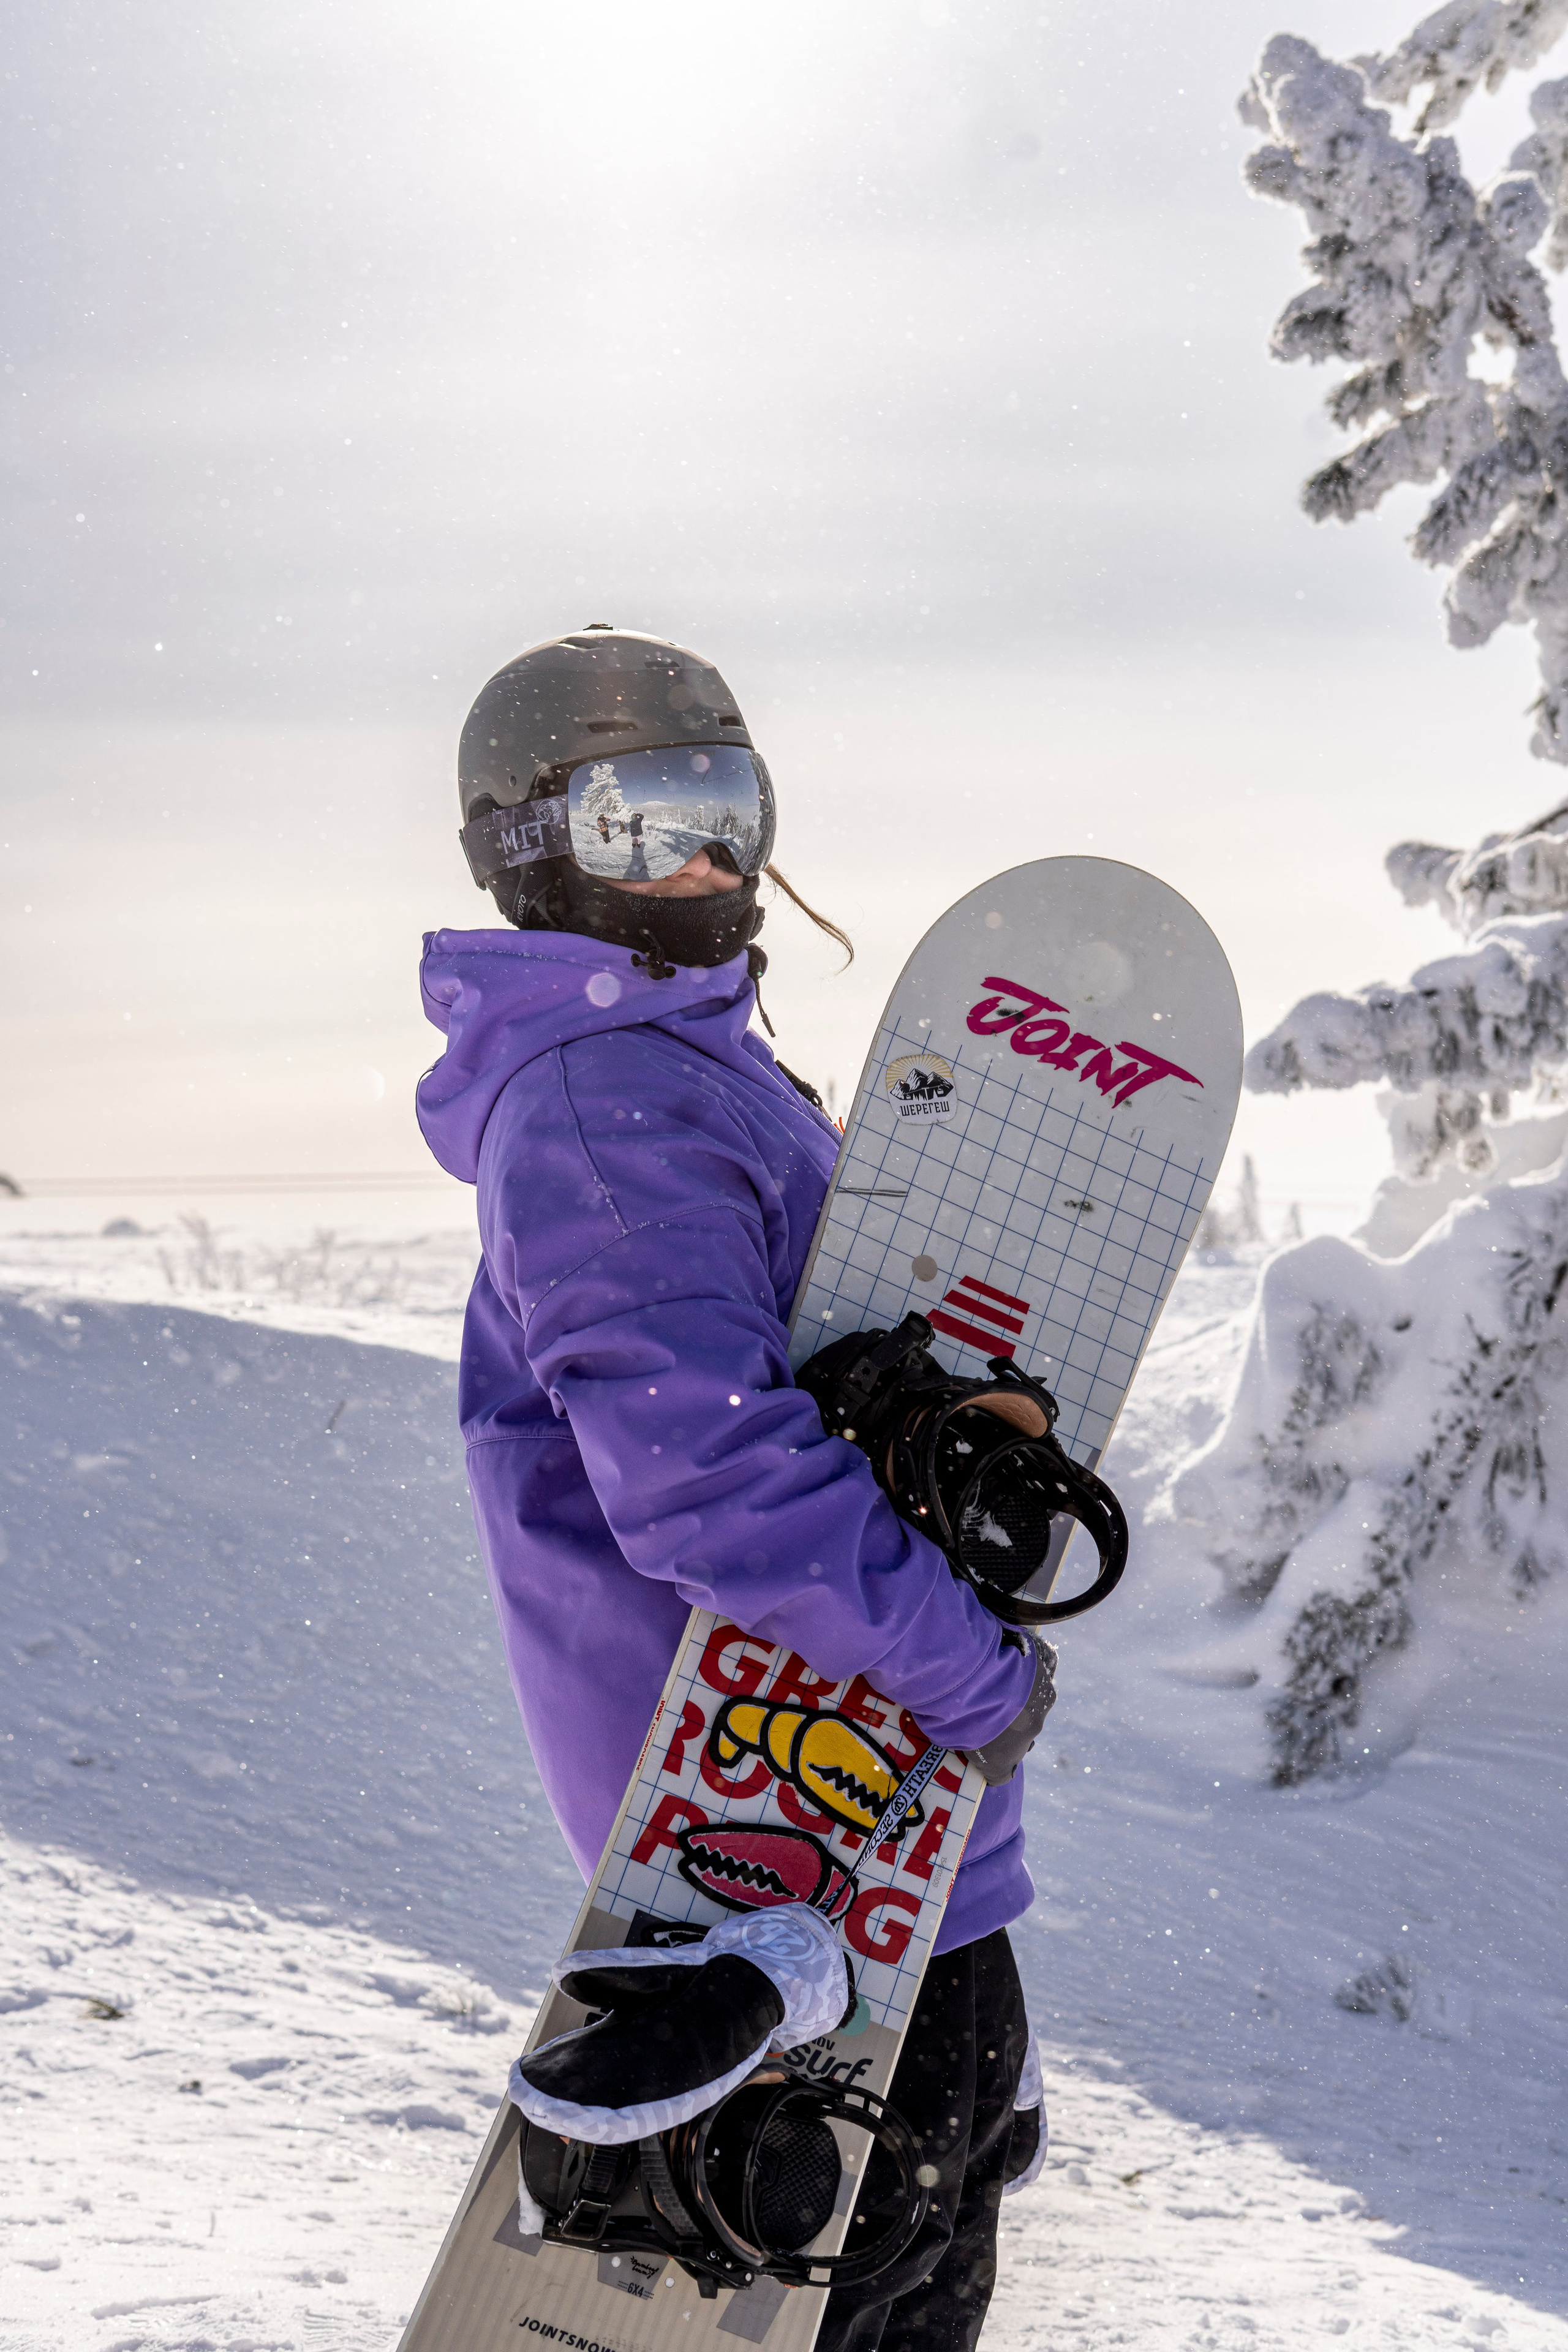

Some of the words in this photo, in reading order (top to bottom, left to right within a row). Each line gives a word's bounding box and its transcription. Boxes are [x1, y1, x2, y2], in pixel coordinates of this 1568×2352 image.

[516, 894, 526, 922] KYOTO
[966, 976, 1204, 1109] JOINT
[899, 1101, 951, 1117] ШЕРЕГЕШ
[946, 1877, 955, 1902] JOINT
[954, 1828, 971, 1877] SNOWBOARDS
[627, 2282, 644, 2297] 6X4
